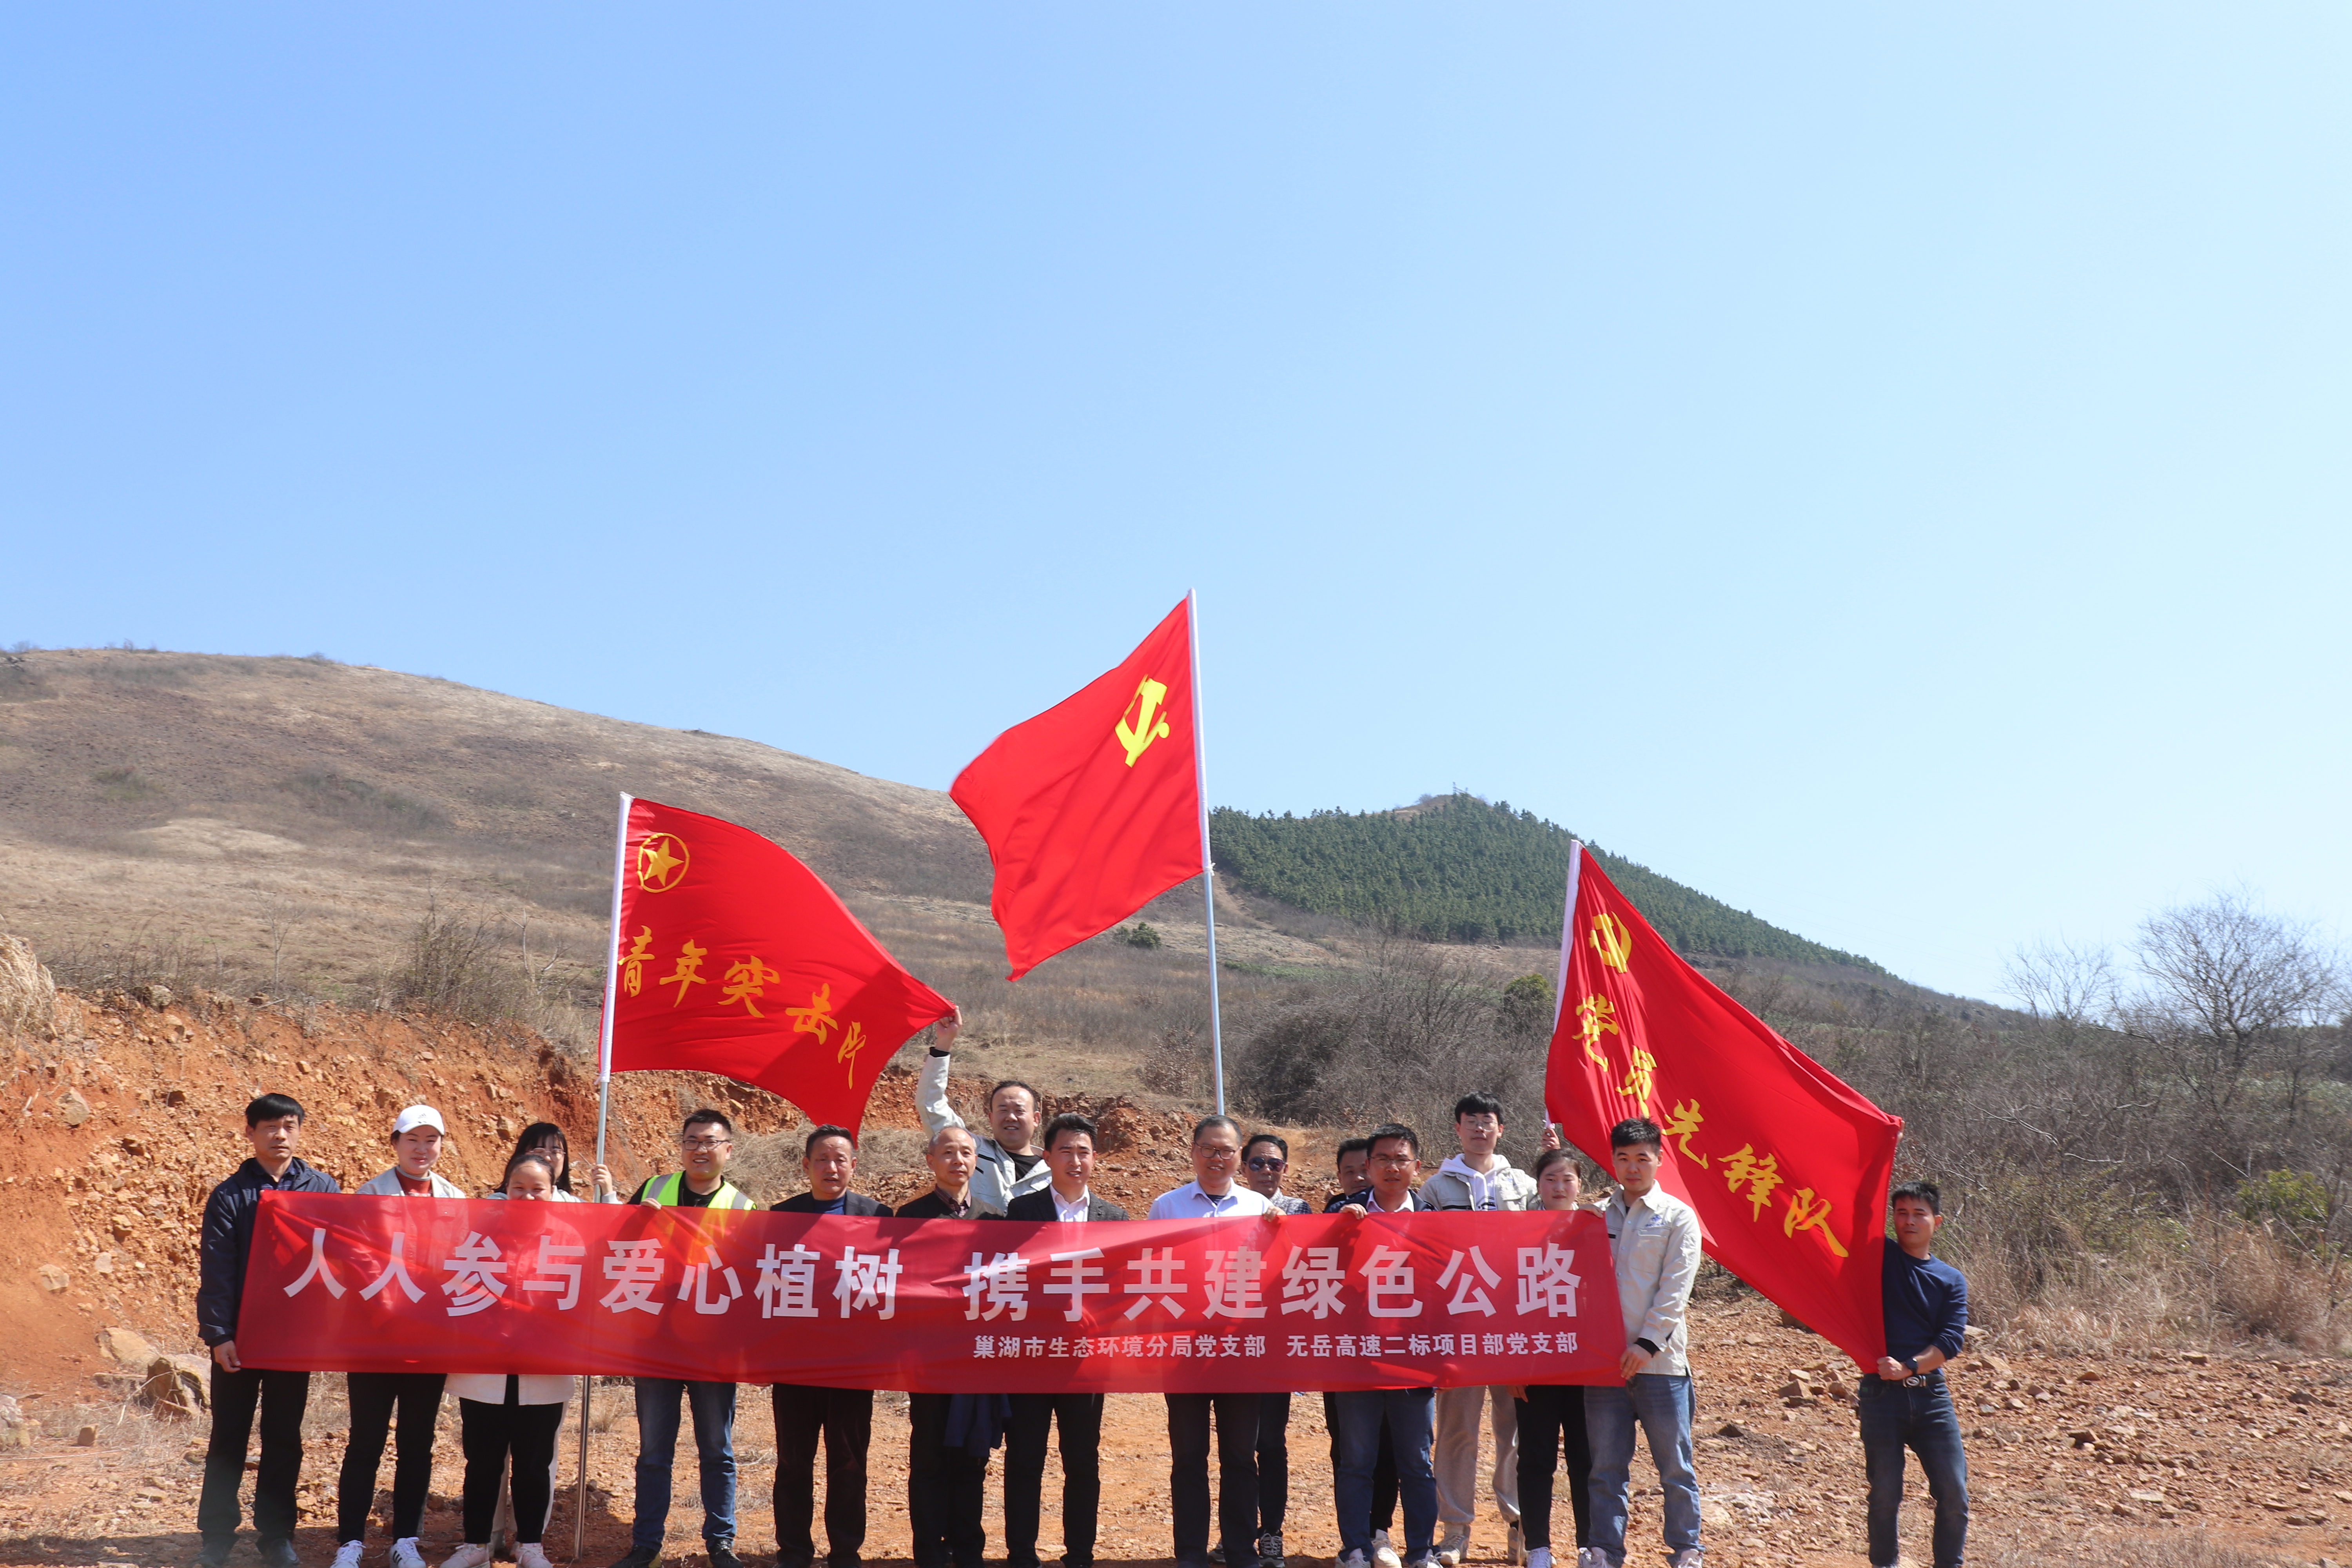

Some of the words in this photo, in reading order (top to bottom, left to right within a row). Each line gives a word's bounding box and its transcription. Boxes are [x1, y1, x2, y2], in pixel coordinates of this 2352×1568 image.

[283, 1227, 904, 1321] 人人参与爱心植树
[963, 1242, 1582, 1322] 携手共建绿色公路
[973, 1334, 1266, 1359] 巢湖市生态环境分局党支部
[1286, 1331, 1578, 1357] 无岳高速二标项目部党支部
